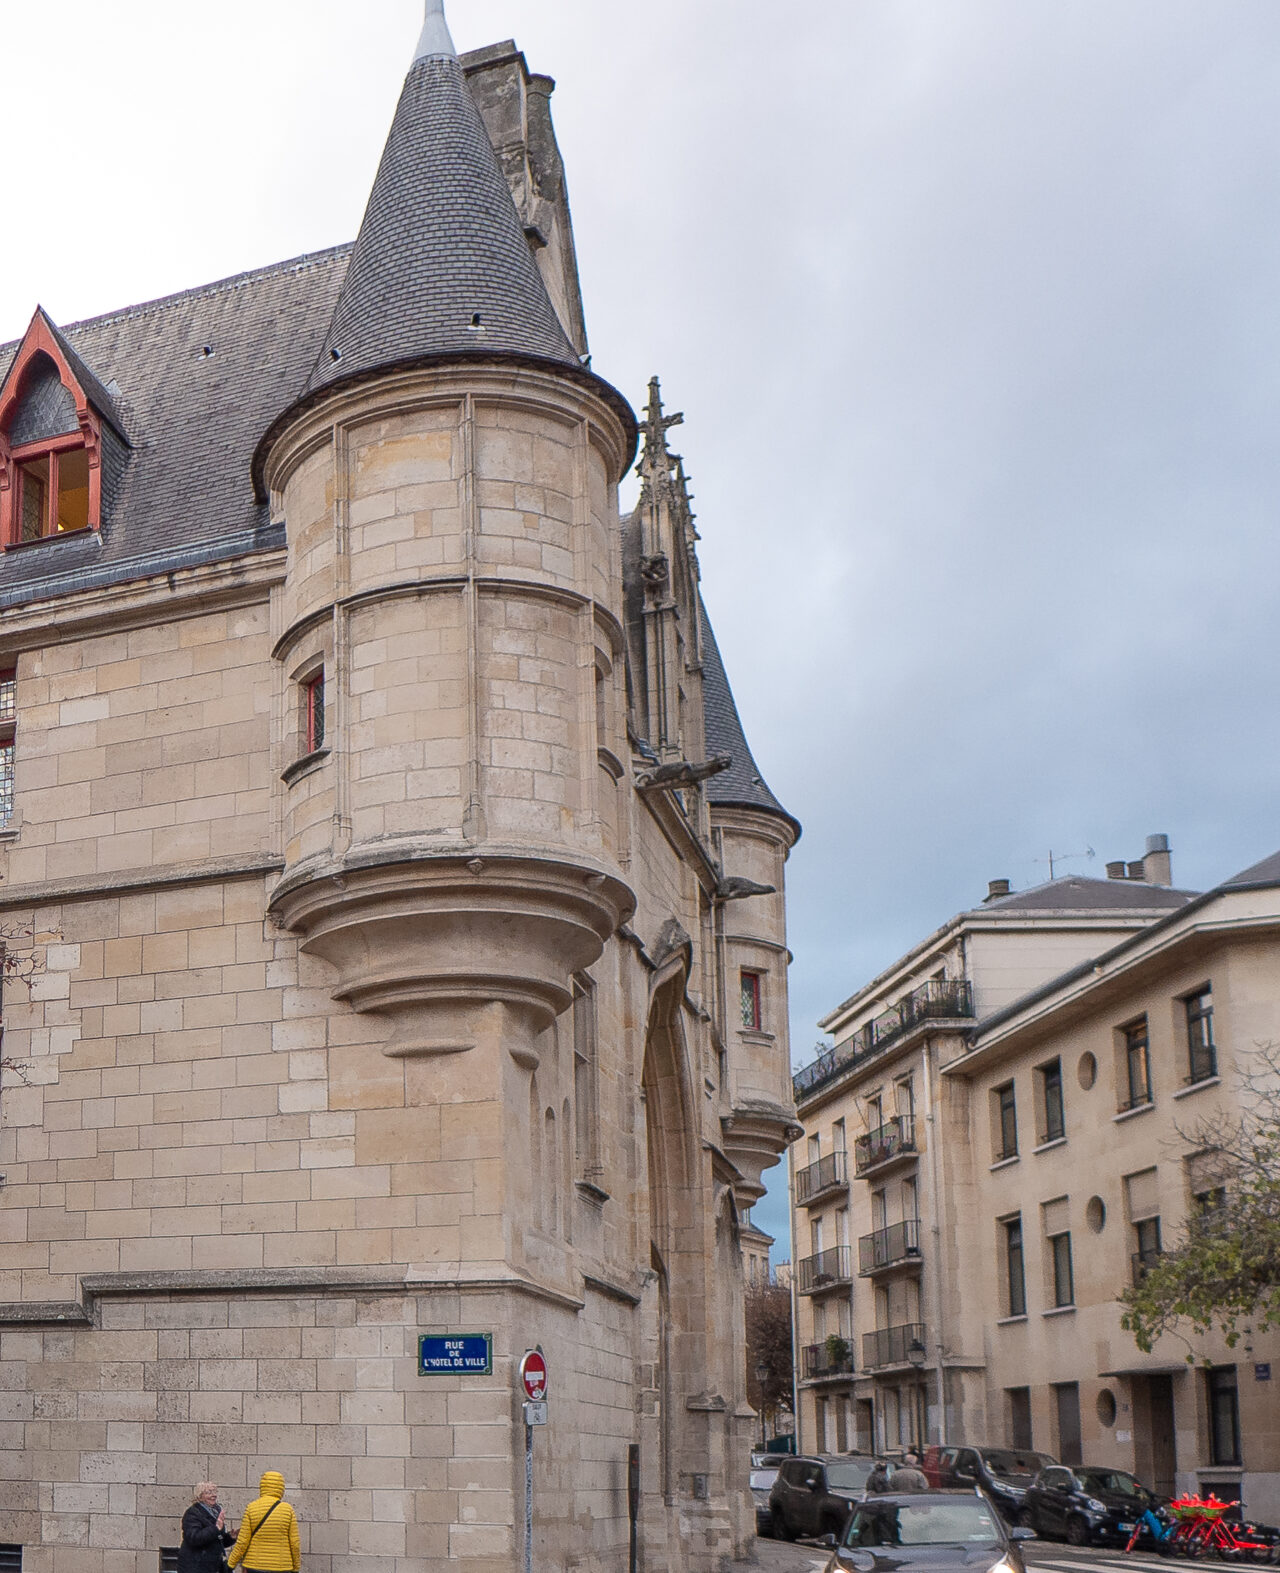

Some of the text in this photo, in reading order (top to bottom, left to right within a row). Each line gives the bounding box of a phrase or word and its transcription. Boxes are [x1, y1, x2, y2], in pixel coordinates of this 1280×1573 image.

[444, 1341, 464, 1350] RUE
[454, 1358, 464, 1366] DE
[465, 1358, 486, 1366] VILLE
